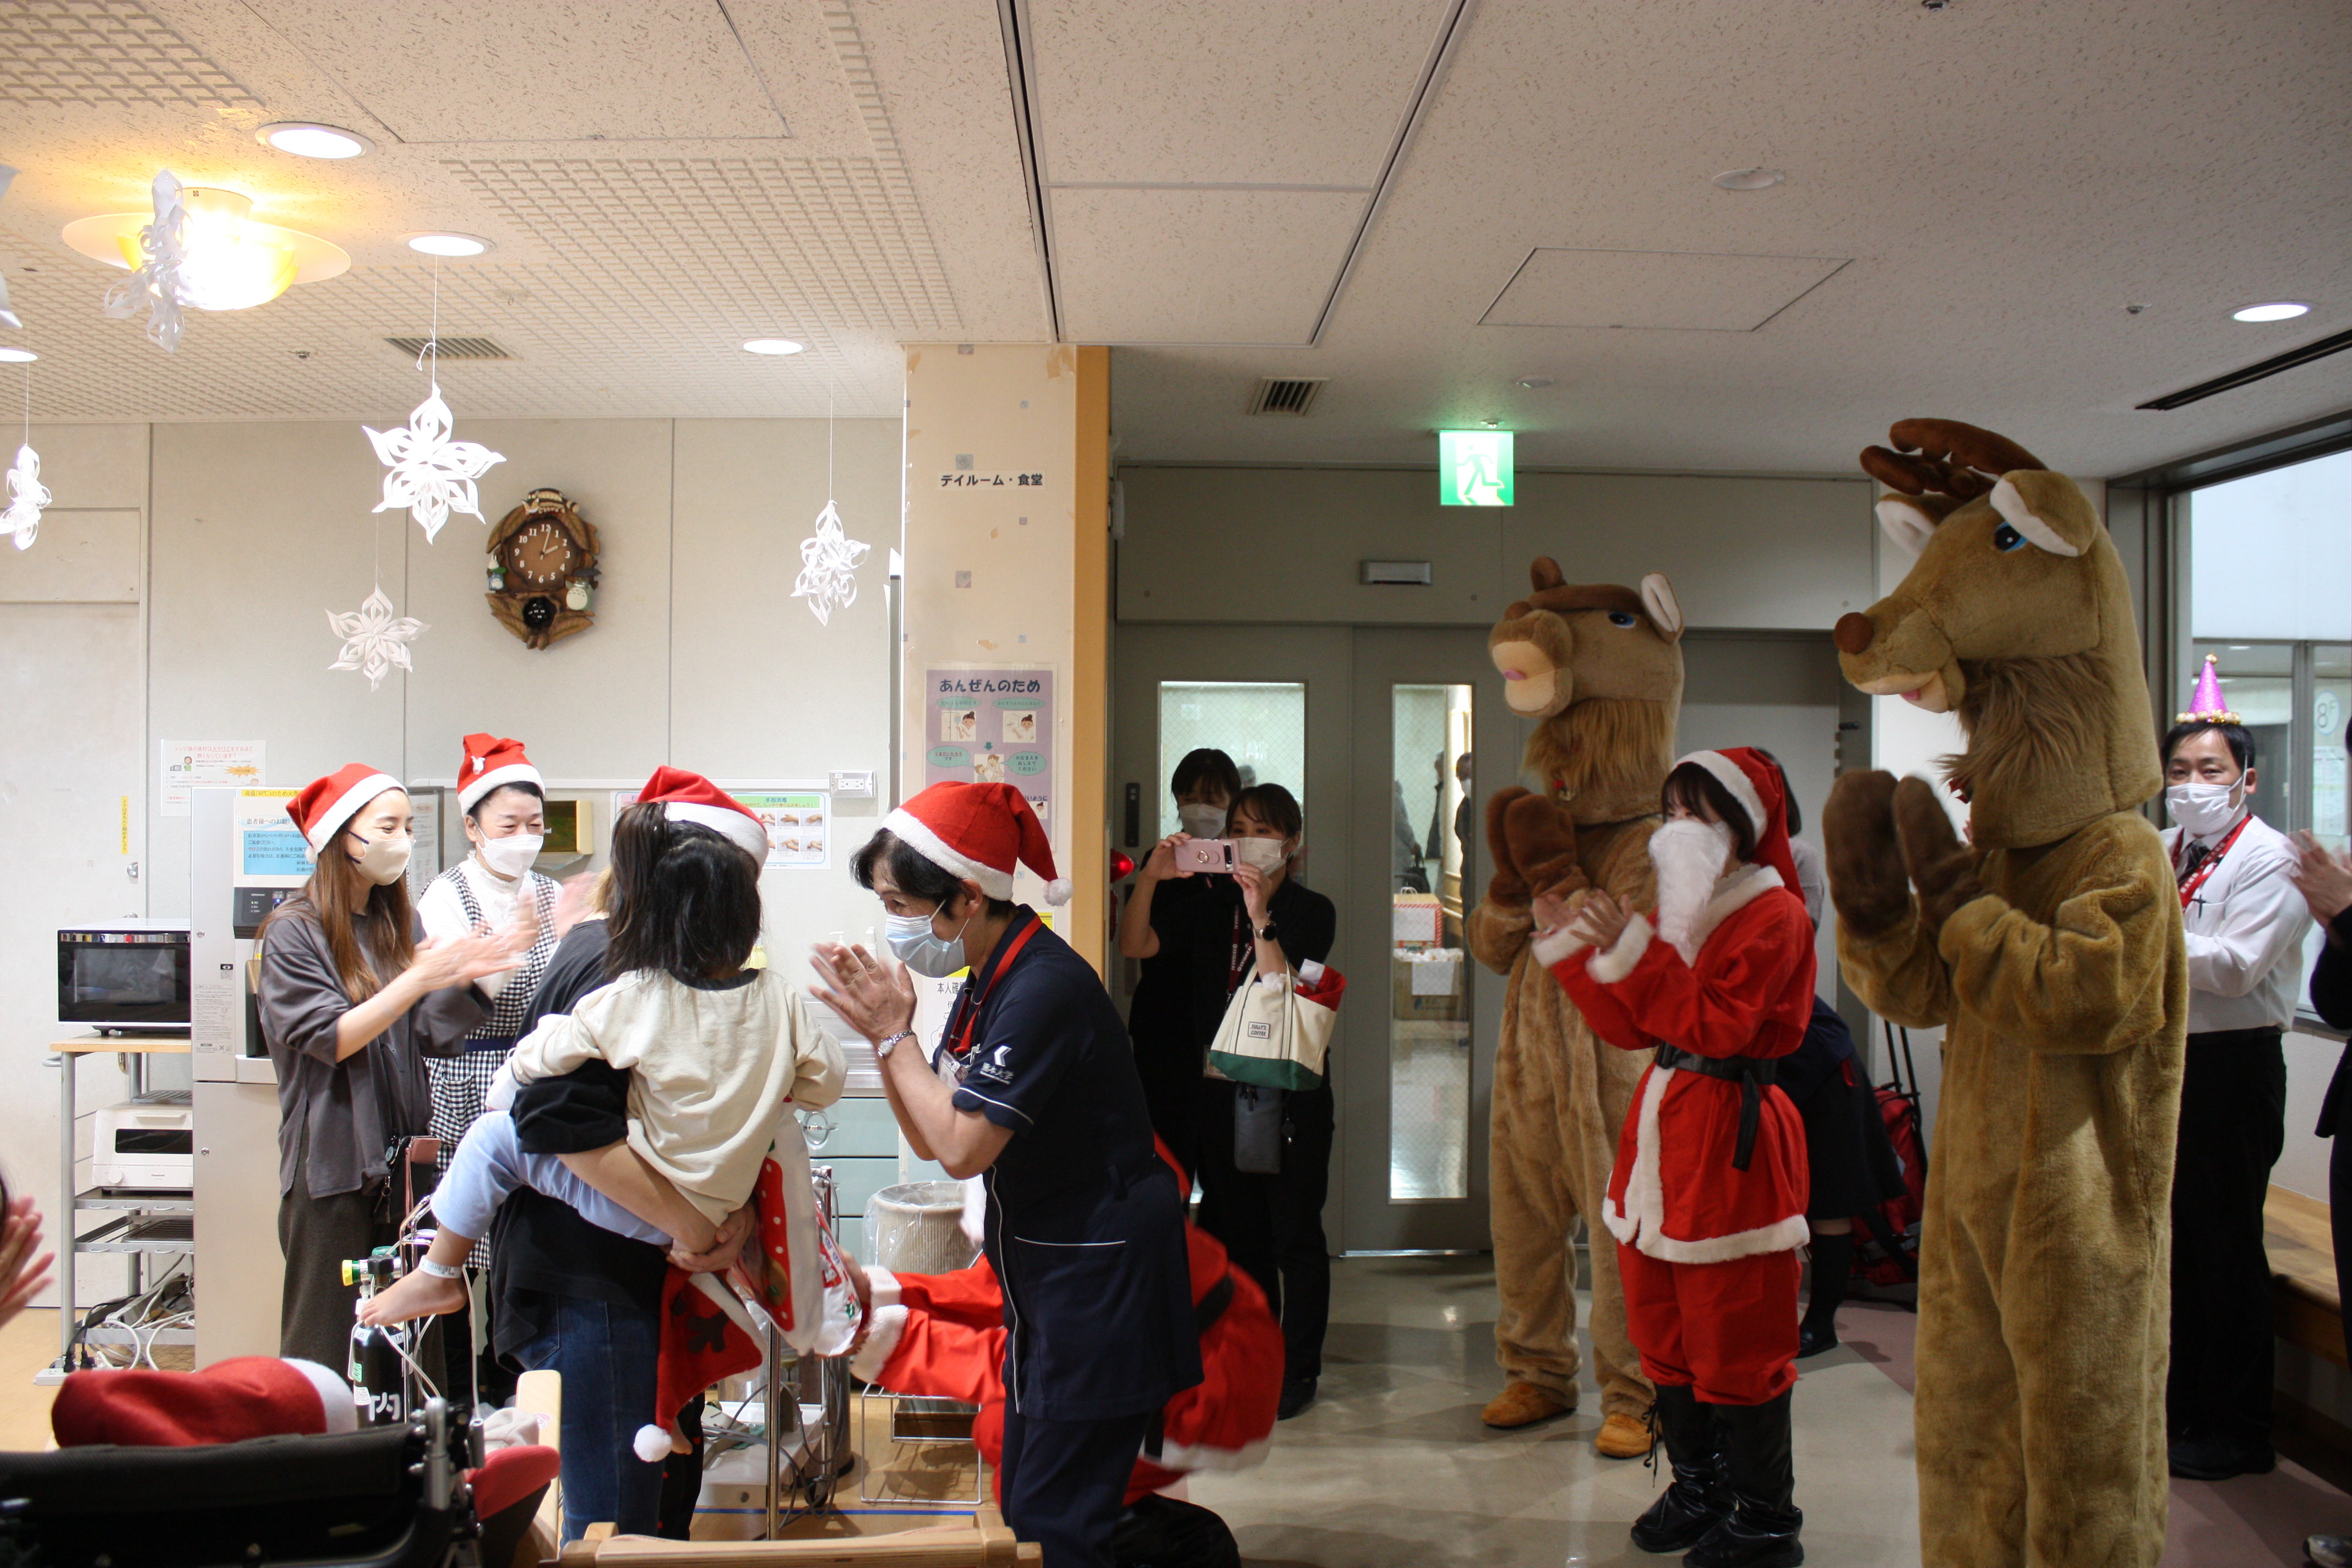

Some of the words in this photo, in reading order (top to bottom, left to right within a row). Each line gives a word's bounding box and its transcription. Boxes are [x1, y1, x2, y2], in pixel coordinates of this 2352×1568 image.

[941, 473, 1043, 487] デイルーム・食堂
[529, 528, 537, 536] 11
[519, 535, 528, 543] 10
[514, 548, 520, 556] 9
[565, 551, 570, 559] 3
[560, 563, 565, 571] 4
[528, 570, 533, 579] 7
[538, 575, 544, 583] 6
[939, 679, 1040, 692] あんぜんのため
